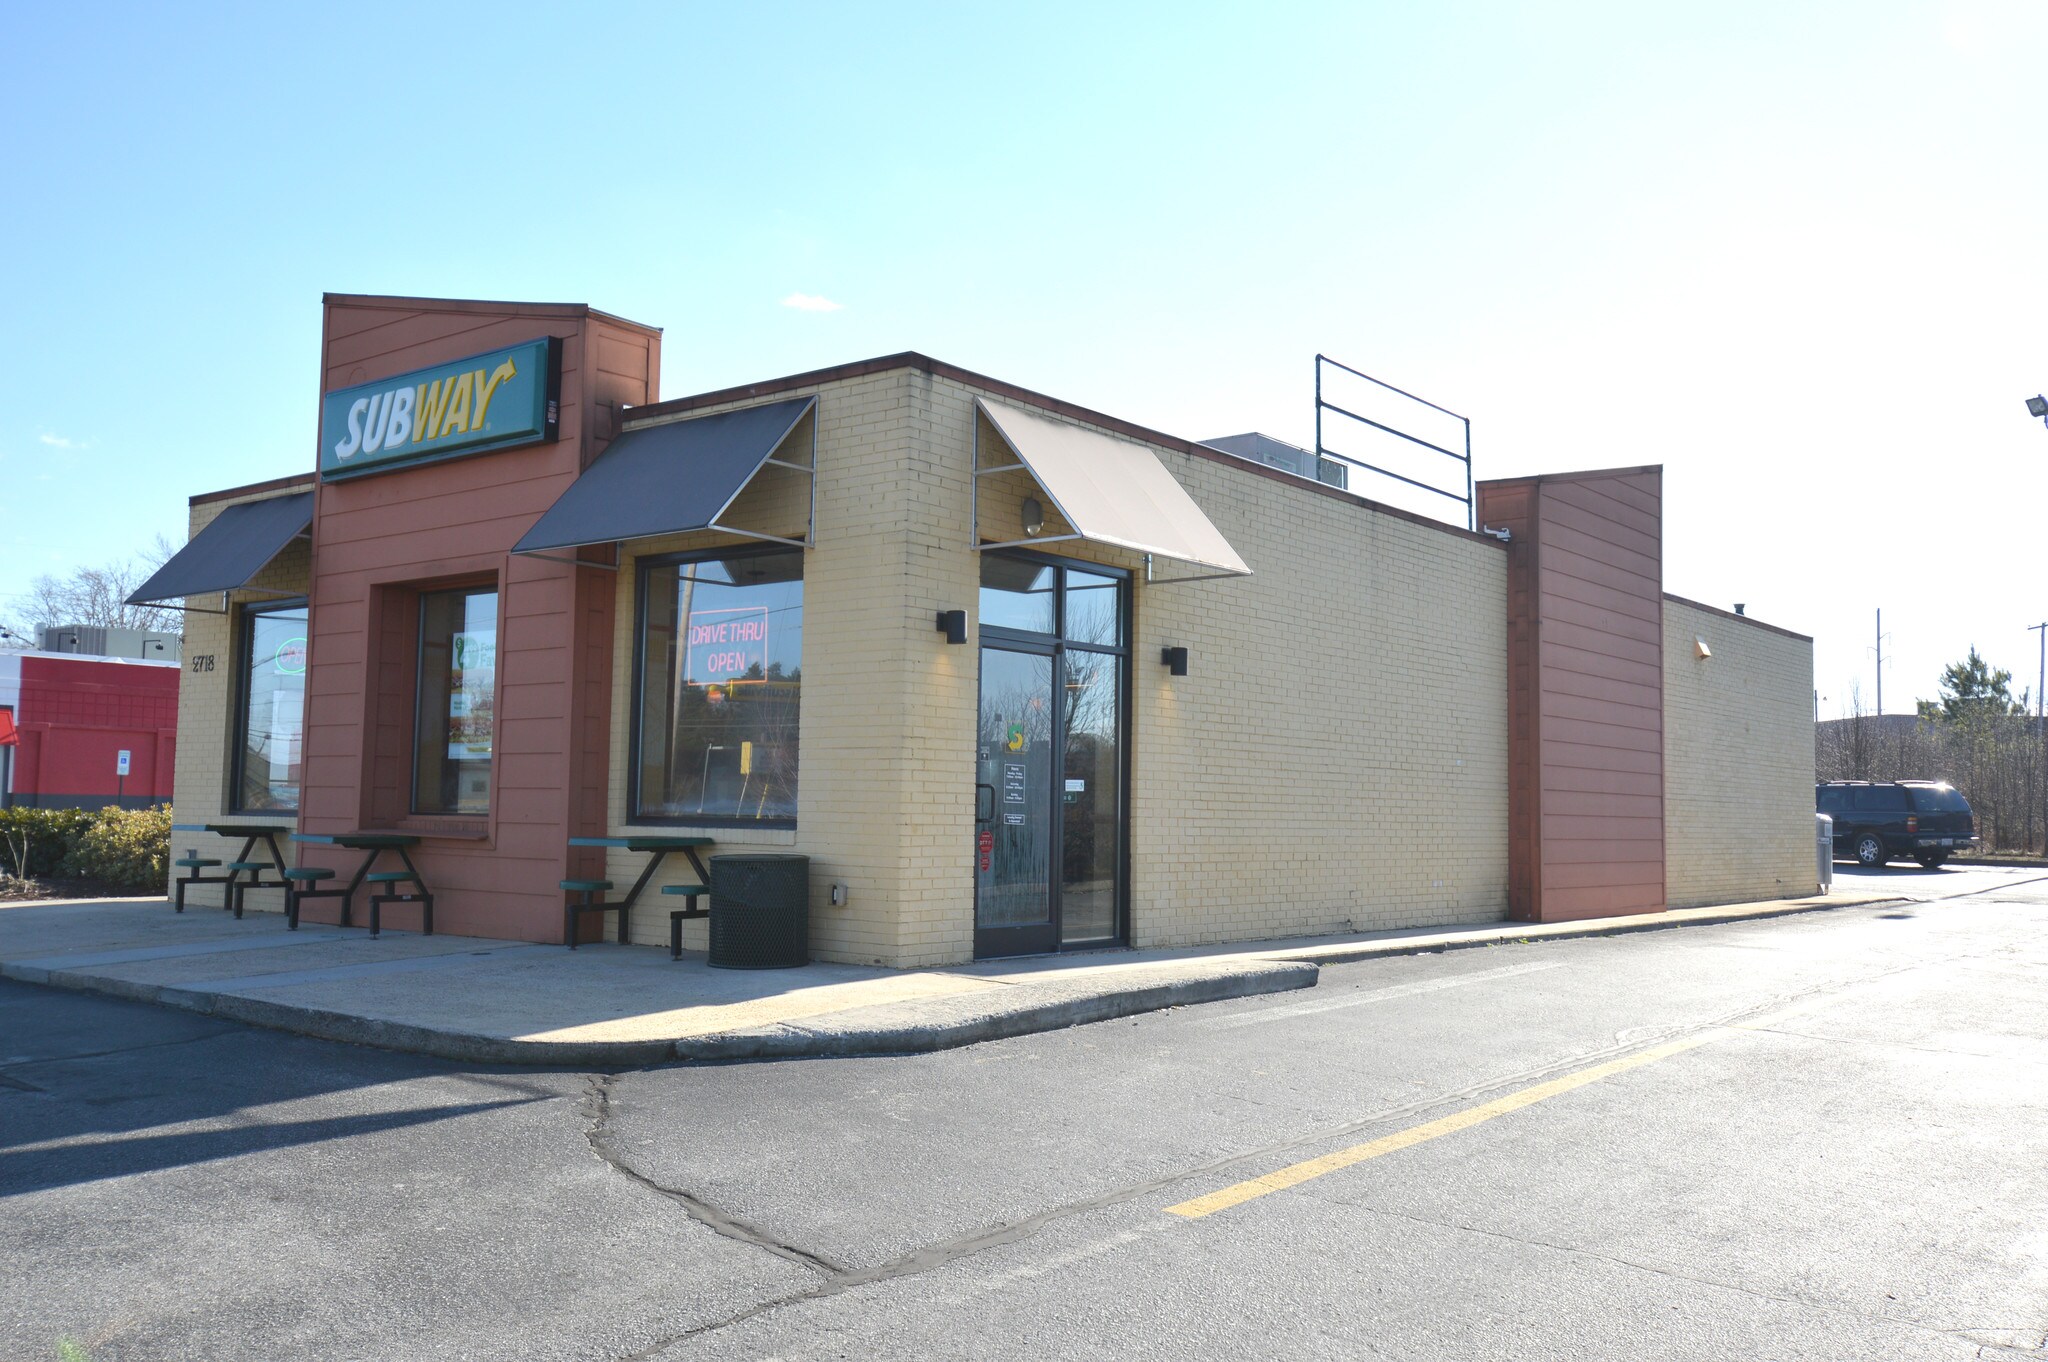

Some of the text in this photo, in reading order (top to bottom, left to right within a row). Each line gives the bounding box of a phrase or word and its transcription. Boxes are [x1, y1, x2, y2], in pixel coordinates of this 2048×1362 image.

[335, 356, 518, 463] SUBWAY
[691, 621, 765, 645] DRIVE THRU
[192, 654, 215, 673] 2718
[707, 652, 746, 672] OPEN
